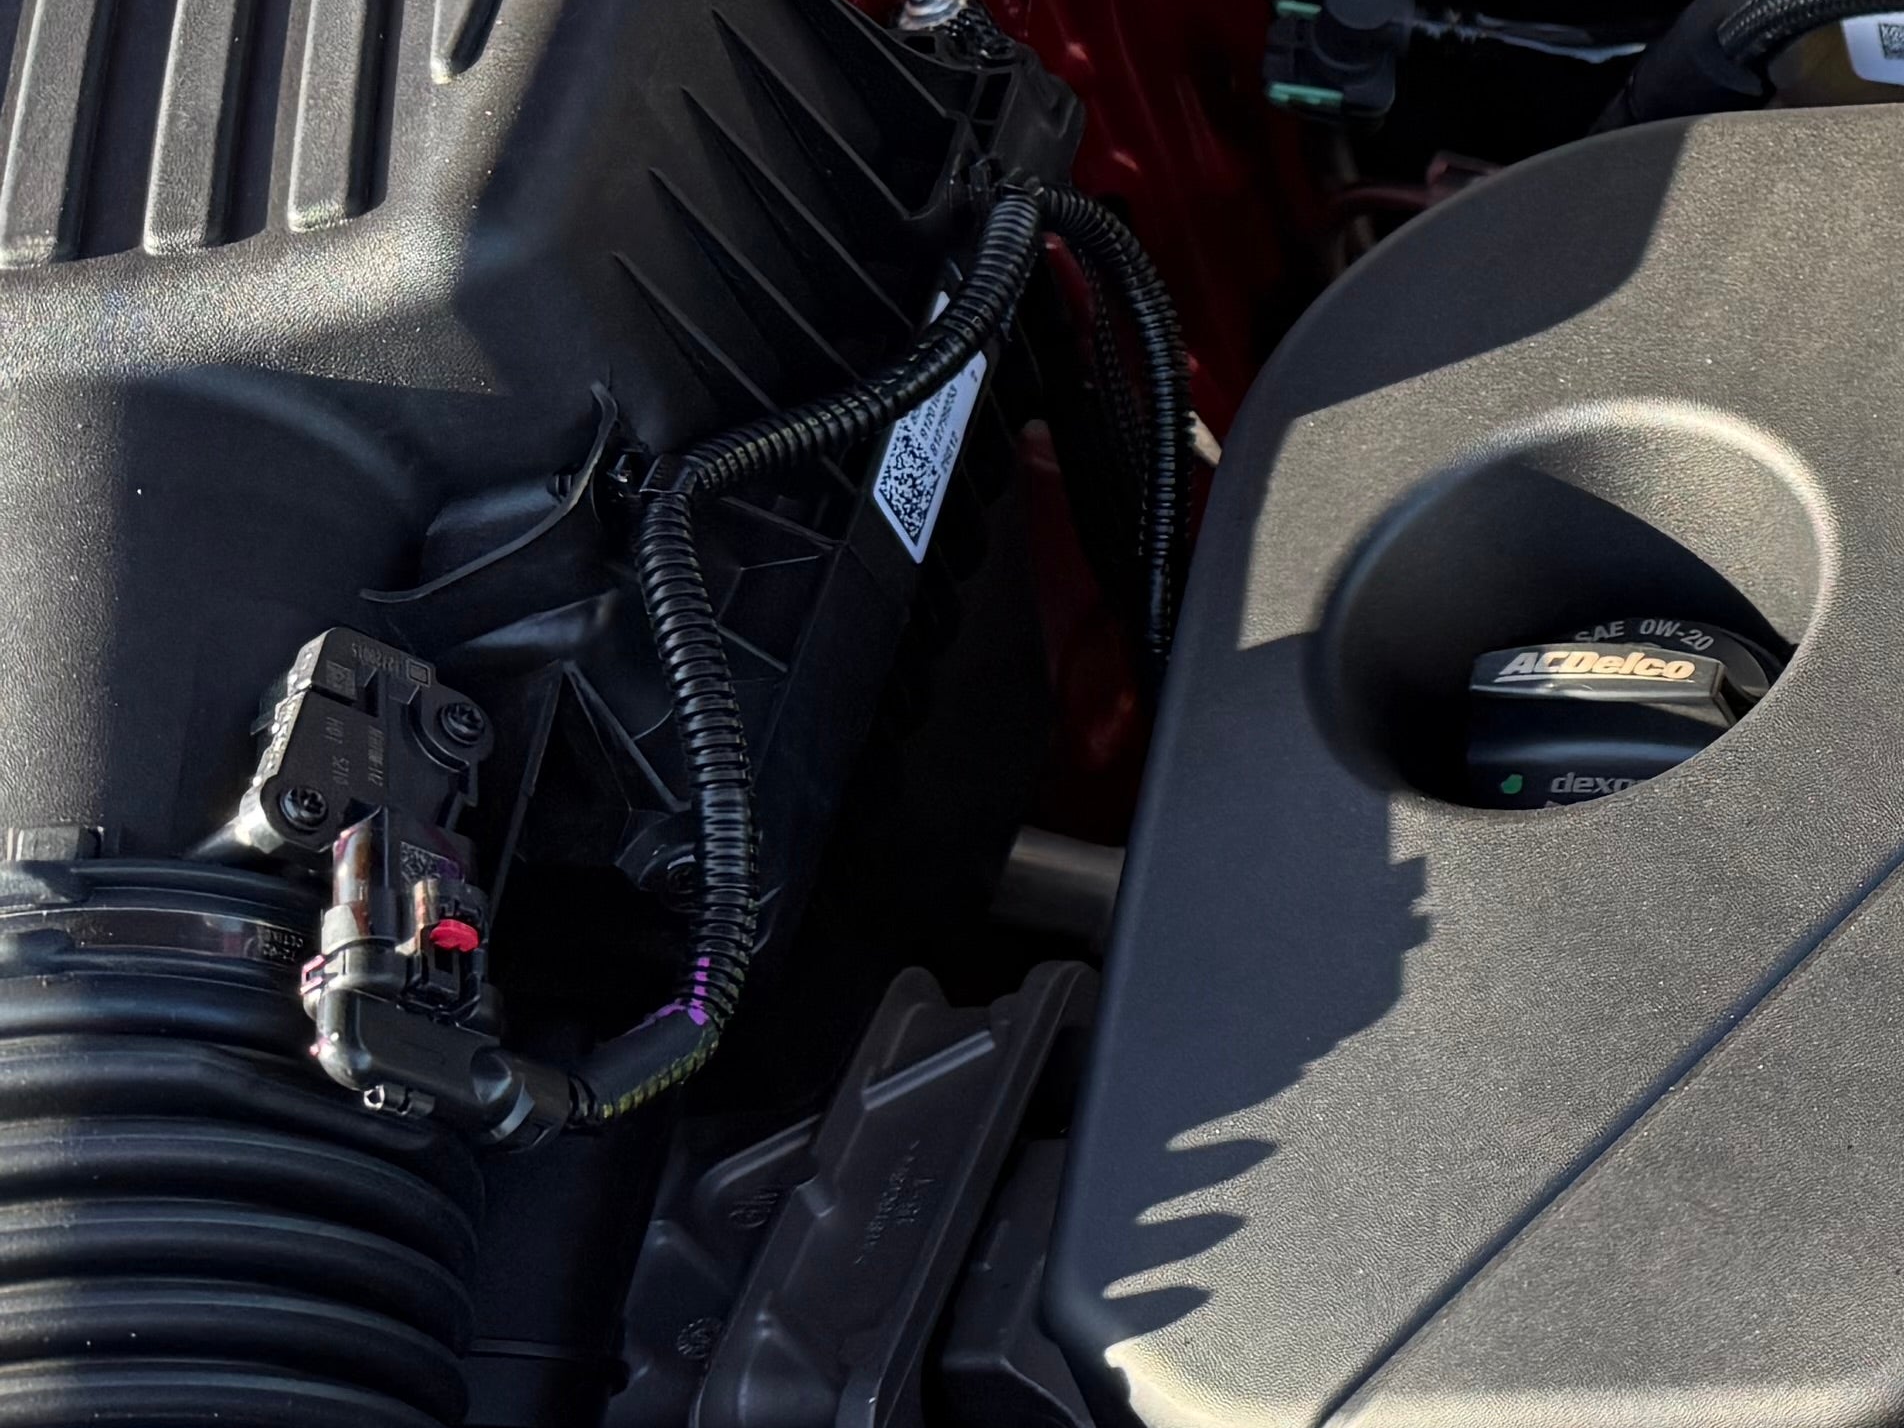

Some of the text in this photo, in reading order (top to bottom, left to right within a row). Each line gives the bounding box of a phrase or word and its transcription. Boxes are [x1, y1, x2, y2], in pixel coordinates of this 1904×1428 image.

[1574, 618, 1715, 652] SAE 0W-20
[1499, 650, 1697, 680] ACDelco
